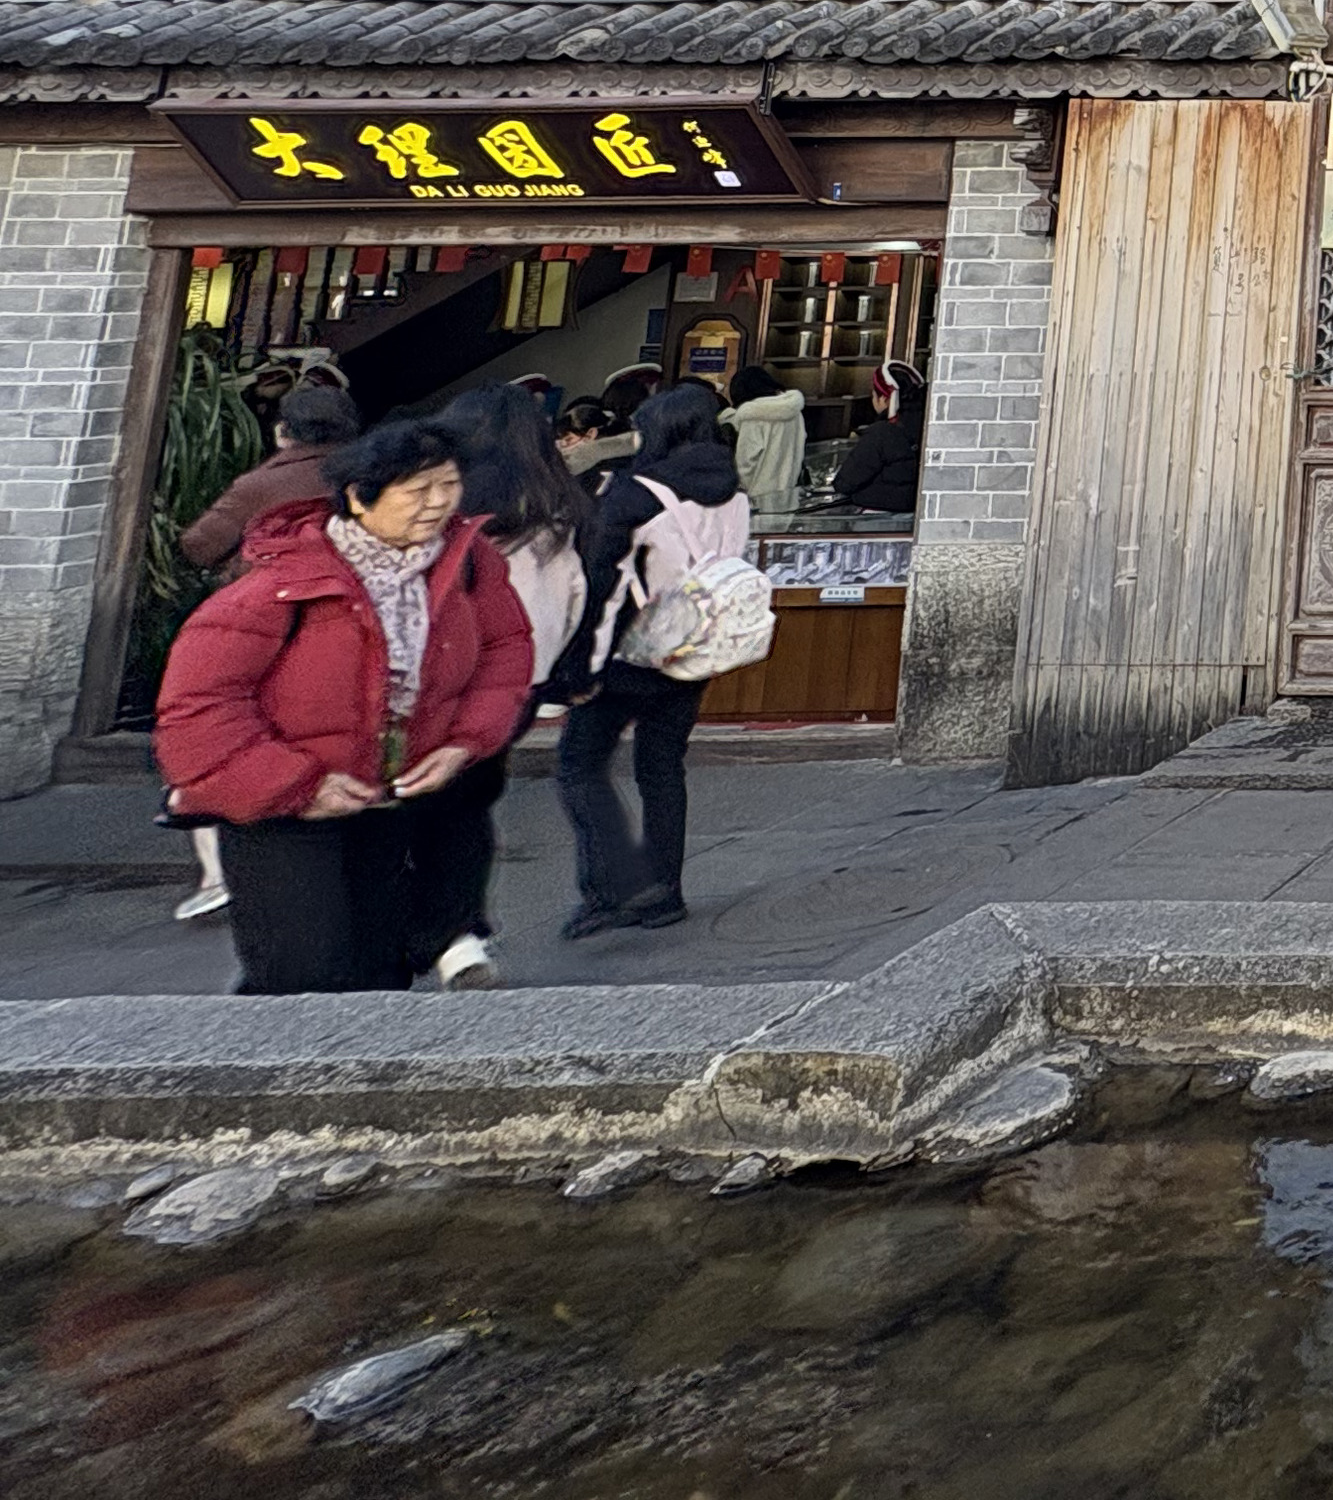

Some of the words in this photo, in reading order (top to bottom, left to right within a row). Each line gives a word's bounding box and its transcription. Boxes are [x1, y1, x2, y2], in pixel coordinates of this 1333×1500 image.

[409, 184, 444, 198] DA
[446, 184, 470, 198] LI
[473, 184, 521, 198] GUO
[524, 184, 585, 197] JIANG
